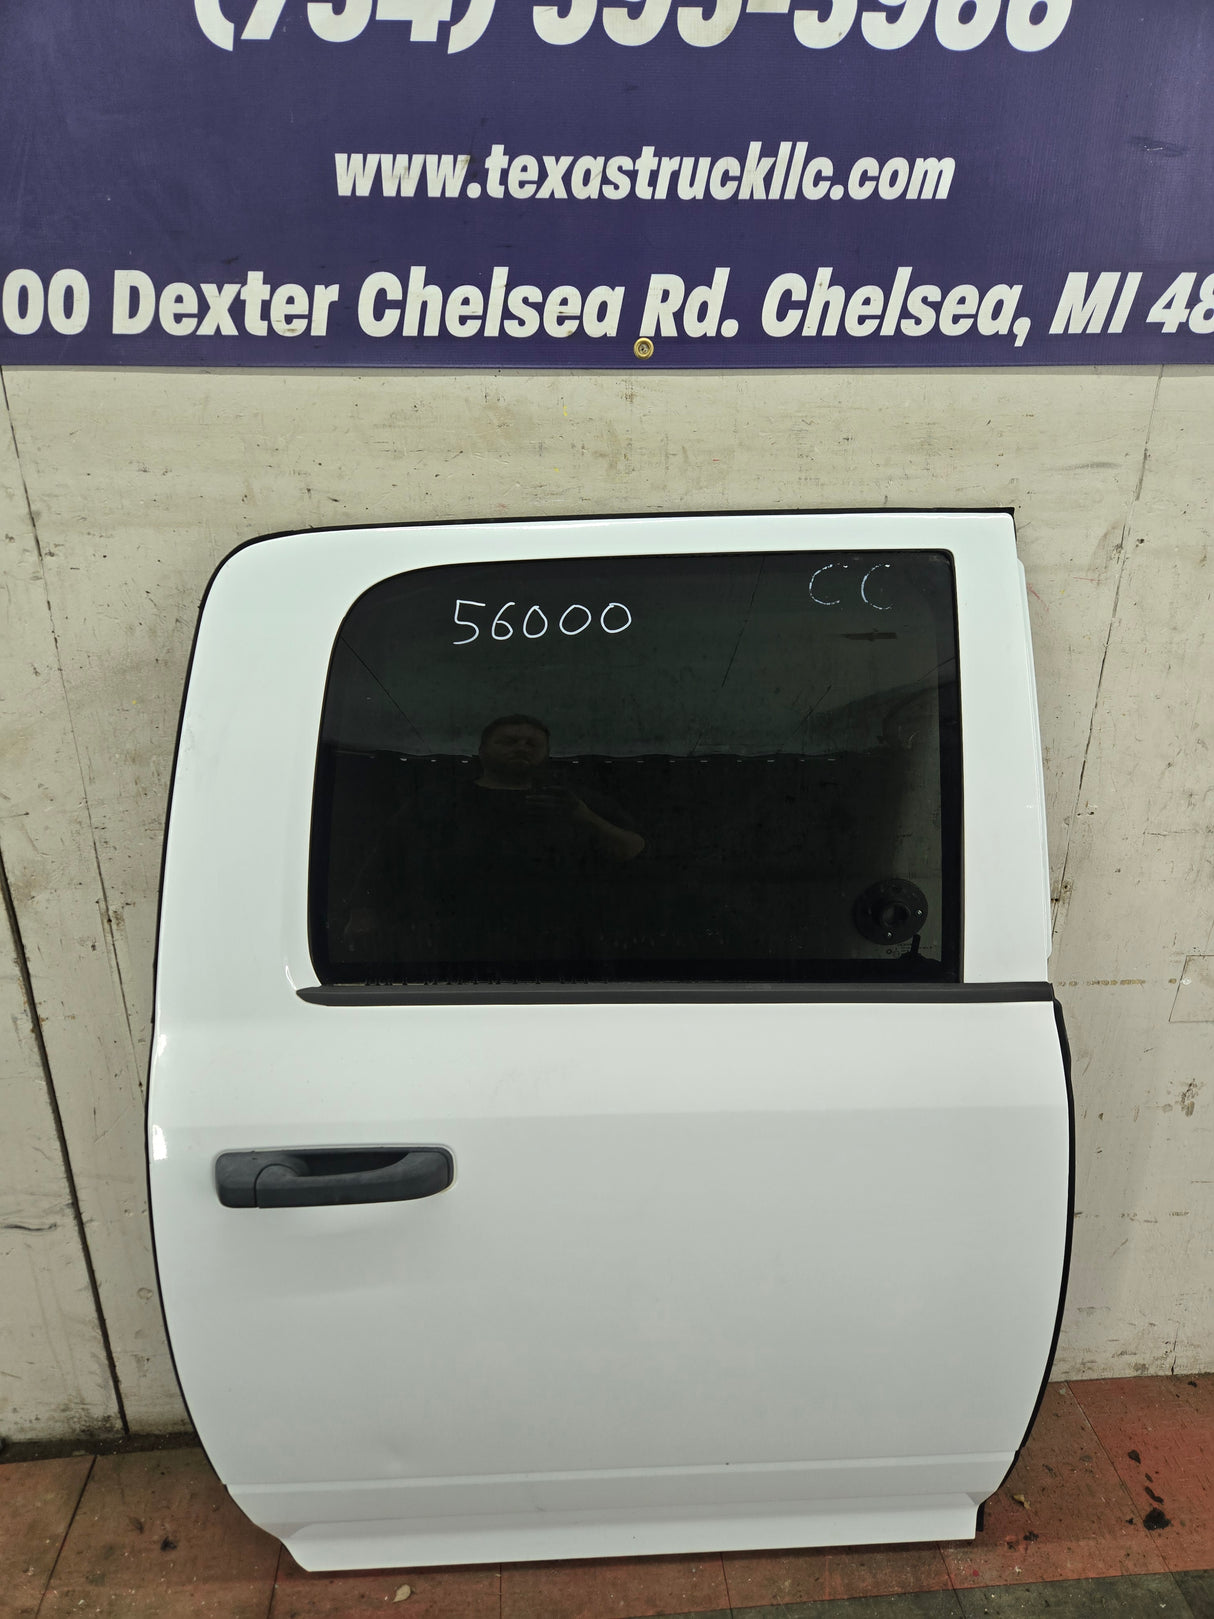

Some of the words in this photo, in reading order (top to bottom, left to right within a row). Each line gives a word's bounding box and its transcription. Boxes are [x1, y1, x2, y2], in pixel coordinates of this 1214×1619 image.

[335, 142, 956, 200] www.texastruckllc.com
[2, 268, 90, 335] 00
[112, 269, 340, 337] Dexter
[357, 265, 626, 338] Chelsea
[639, 267, 740, 338] Rd.
[761, 266, 1032, 347] Chelsea,
[1048, 271, 1143, 335] MI
[452, 599, 633, 646] 56000
